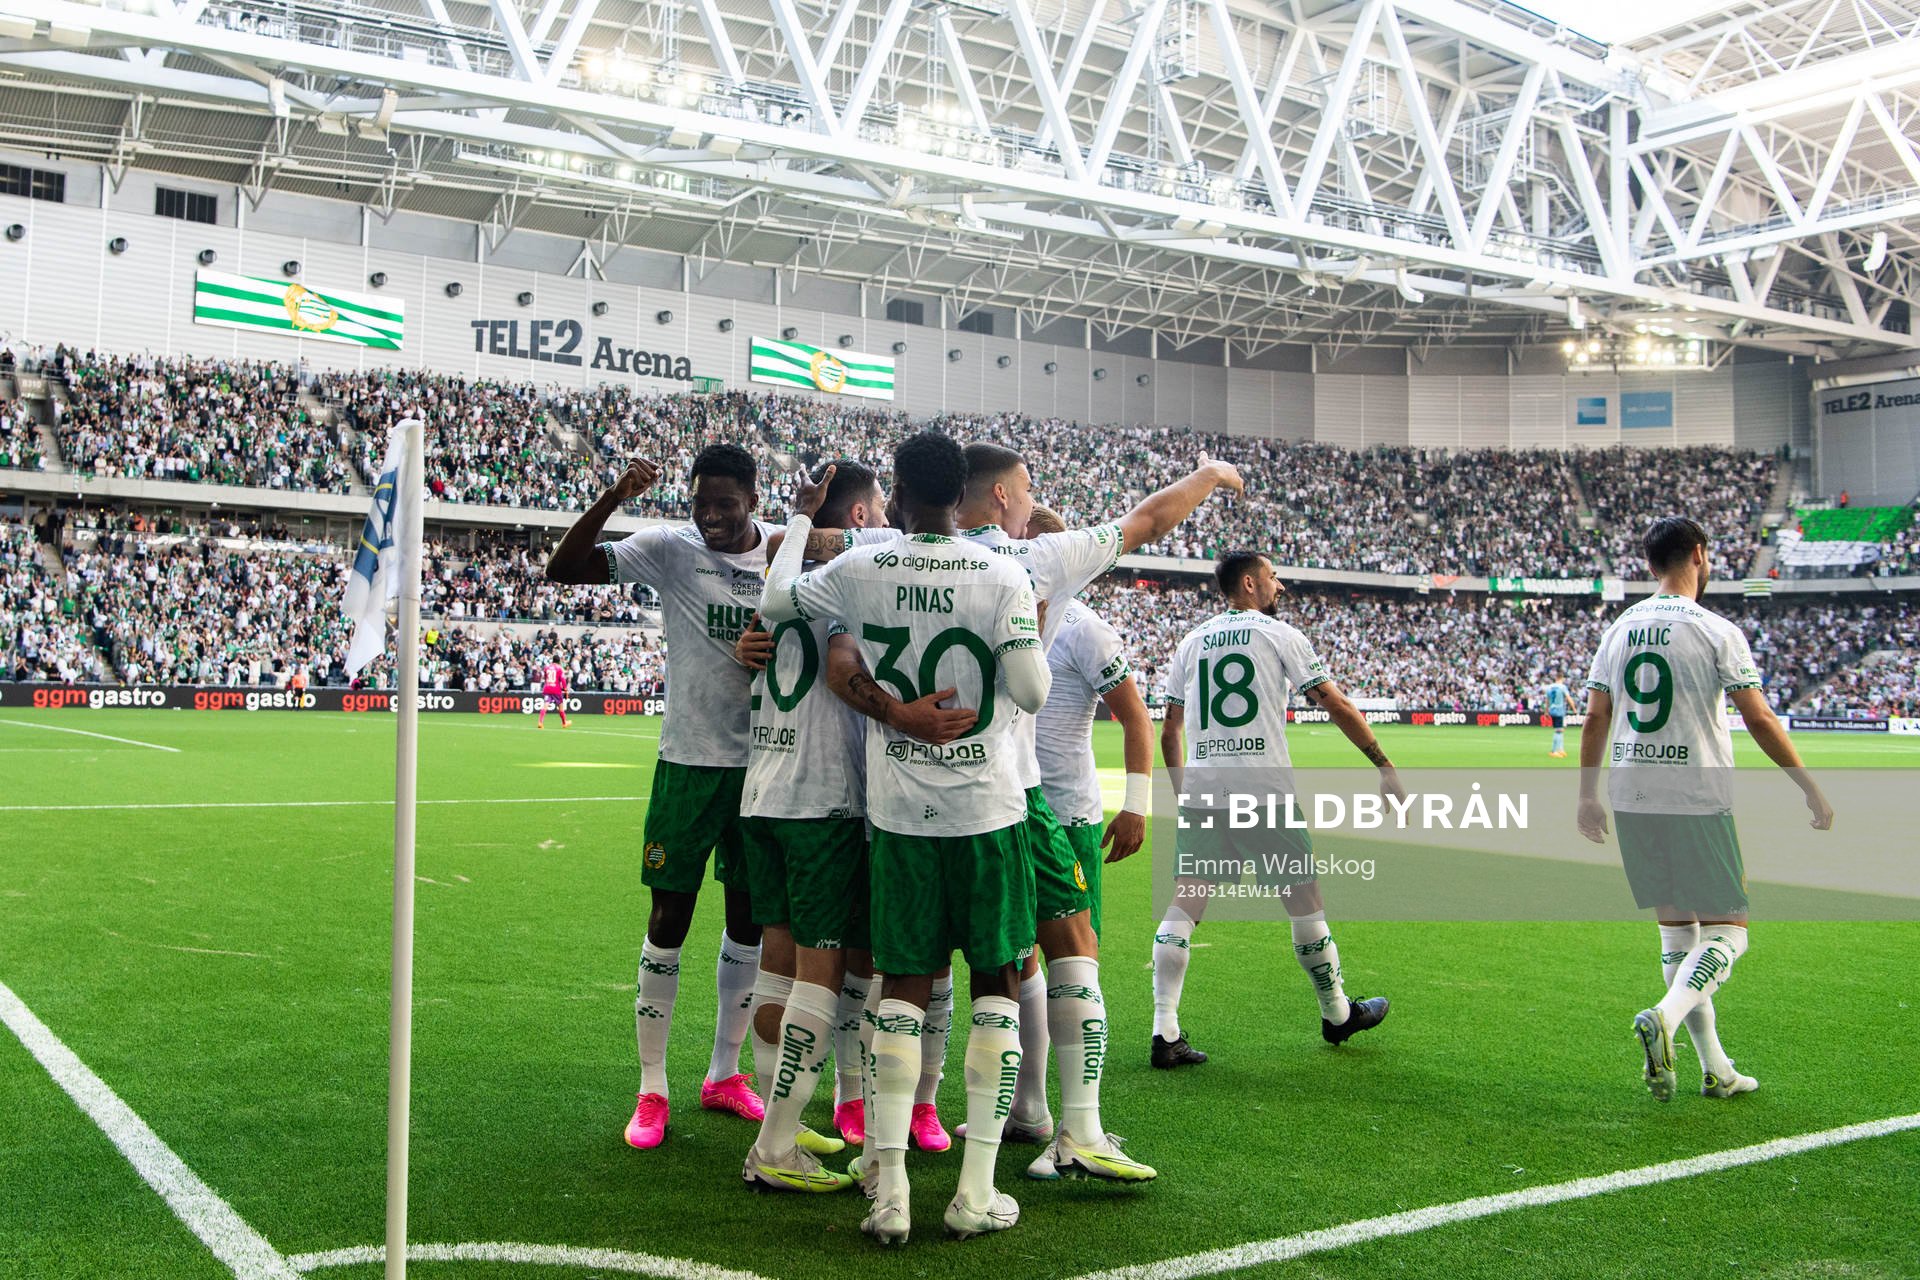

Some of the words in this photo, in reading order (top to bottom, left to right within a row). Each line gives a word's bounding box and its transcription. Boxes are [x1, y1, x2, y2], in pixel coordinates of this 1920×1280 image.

[471, 319, 582, 366] TELE2
[590, 336, 693, 382] Arena
[1824, 392, 1872, 414] TELE2
[696, 567, 720, 576] CRAFT
[902, 554, 989, 573] digipant.se
[896, 586, 955, 614] PINAS
[1203, 629, 1251, 651] SADIKU
[1628, 623, 1673, 647] NALIĆ
[750, 617, 820, 713] 0
[863, 621, 997, 740] 30
[1199, 653, 1259, 731] 18
[1624, 652, 1674, 734] 9
[342, 692, 454, 712] ggmgstro
[1208, 737, 1265, 752] PROJOB
[1625, 743, 1689, 759] PROJOB
[951, 758, 988, 768] WORKWEAR
[1687, 947, 1729, 992] Clinton
[774, 1023, 816, 1100] Clinton
[1081, 1018, 1104, 1081] Clinton
[998, 1050, 1022, 1118] Clinton
